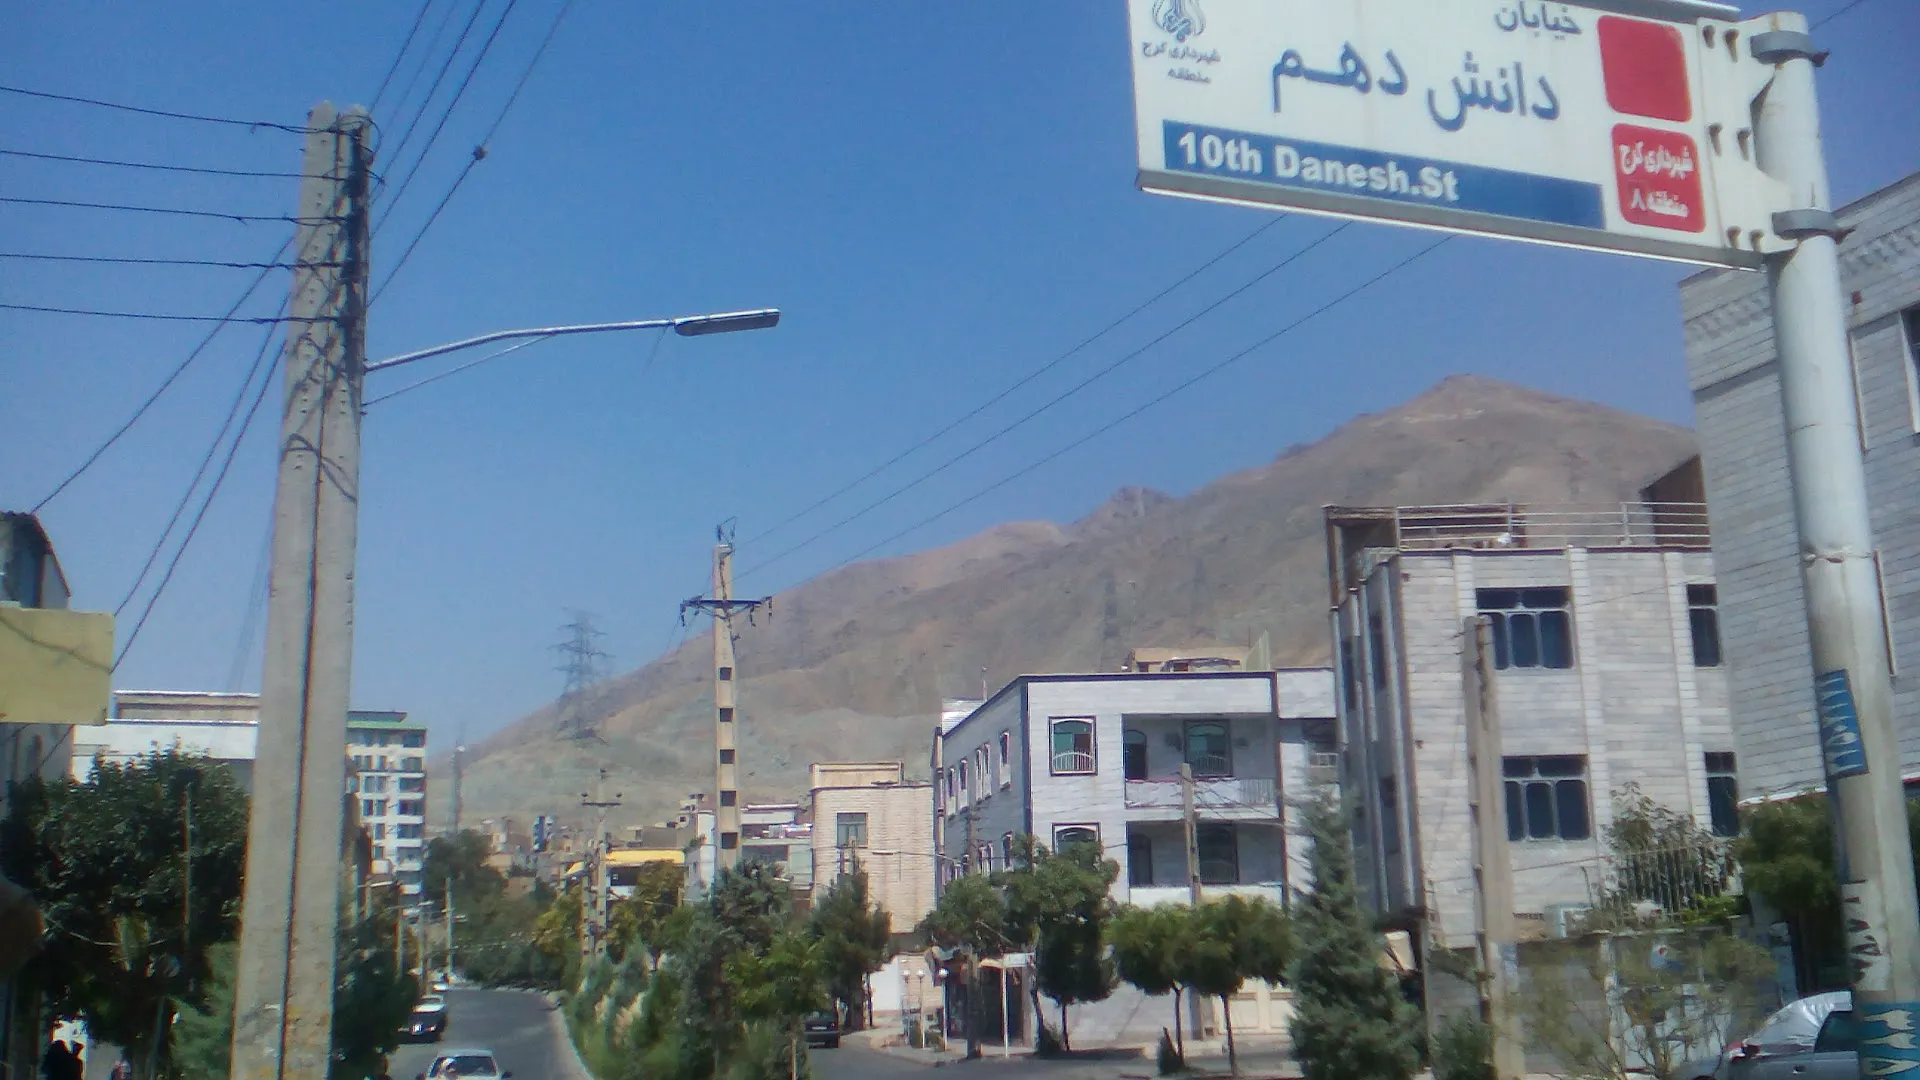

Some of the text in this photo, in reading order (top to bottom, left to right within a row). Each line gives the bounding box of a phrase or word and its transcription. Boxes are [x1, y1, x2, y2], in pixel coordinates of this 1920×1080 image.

[1494, 1, 1583, 39] خیابان
[1273, 41, 1560, 132] دانش دهم
[1178, 131, 1459, 201] 10th Danesh.St
[1647, 190, 1689, 218] منطقه
